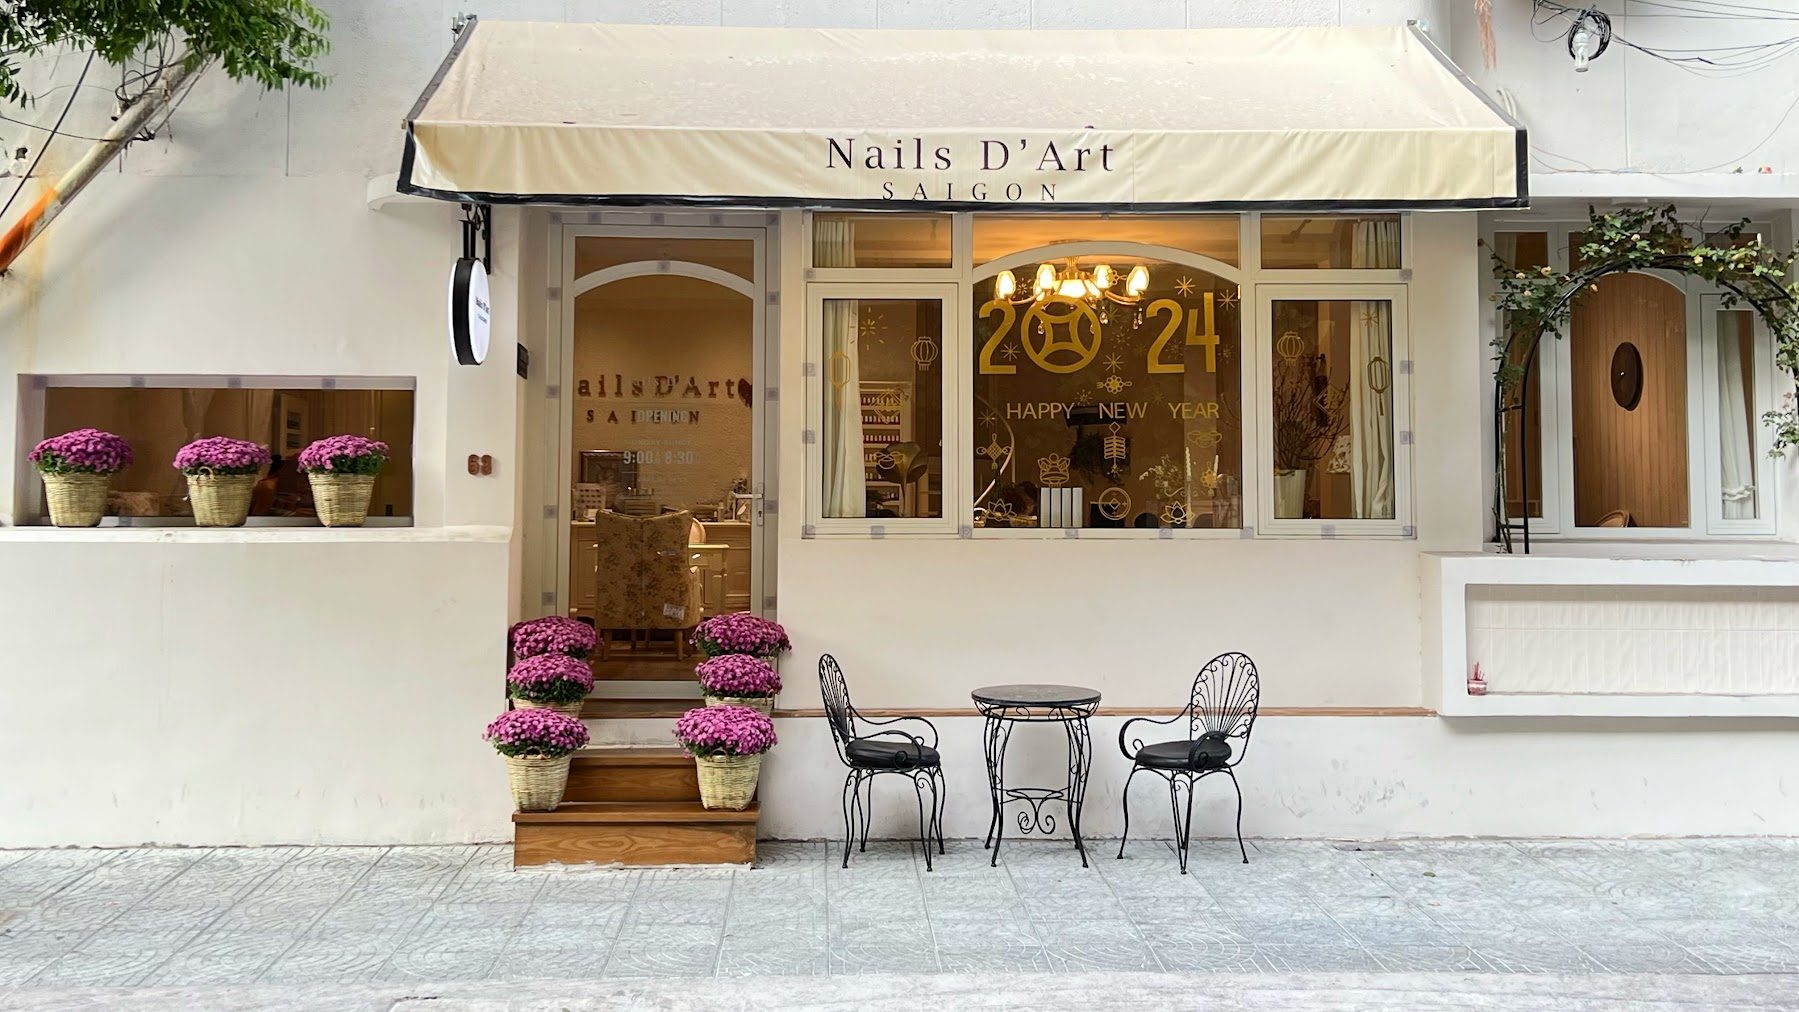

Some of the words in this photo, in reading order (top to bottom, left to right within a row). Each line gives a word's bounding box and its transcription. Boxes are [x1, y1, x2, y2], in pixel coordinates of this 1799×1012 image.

[826, 138, 953, 171] Nails
[980, 138, 1115, 172] D'Art
[882, 181, 1058, 202] SAIGON
[1006, 402, 1075, 419] HAPPY
[1098, 402, 1149, 419] NEW
[1168, 402, 1220, 419] YEAR
